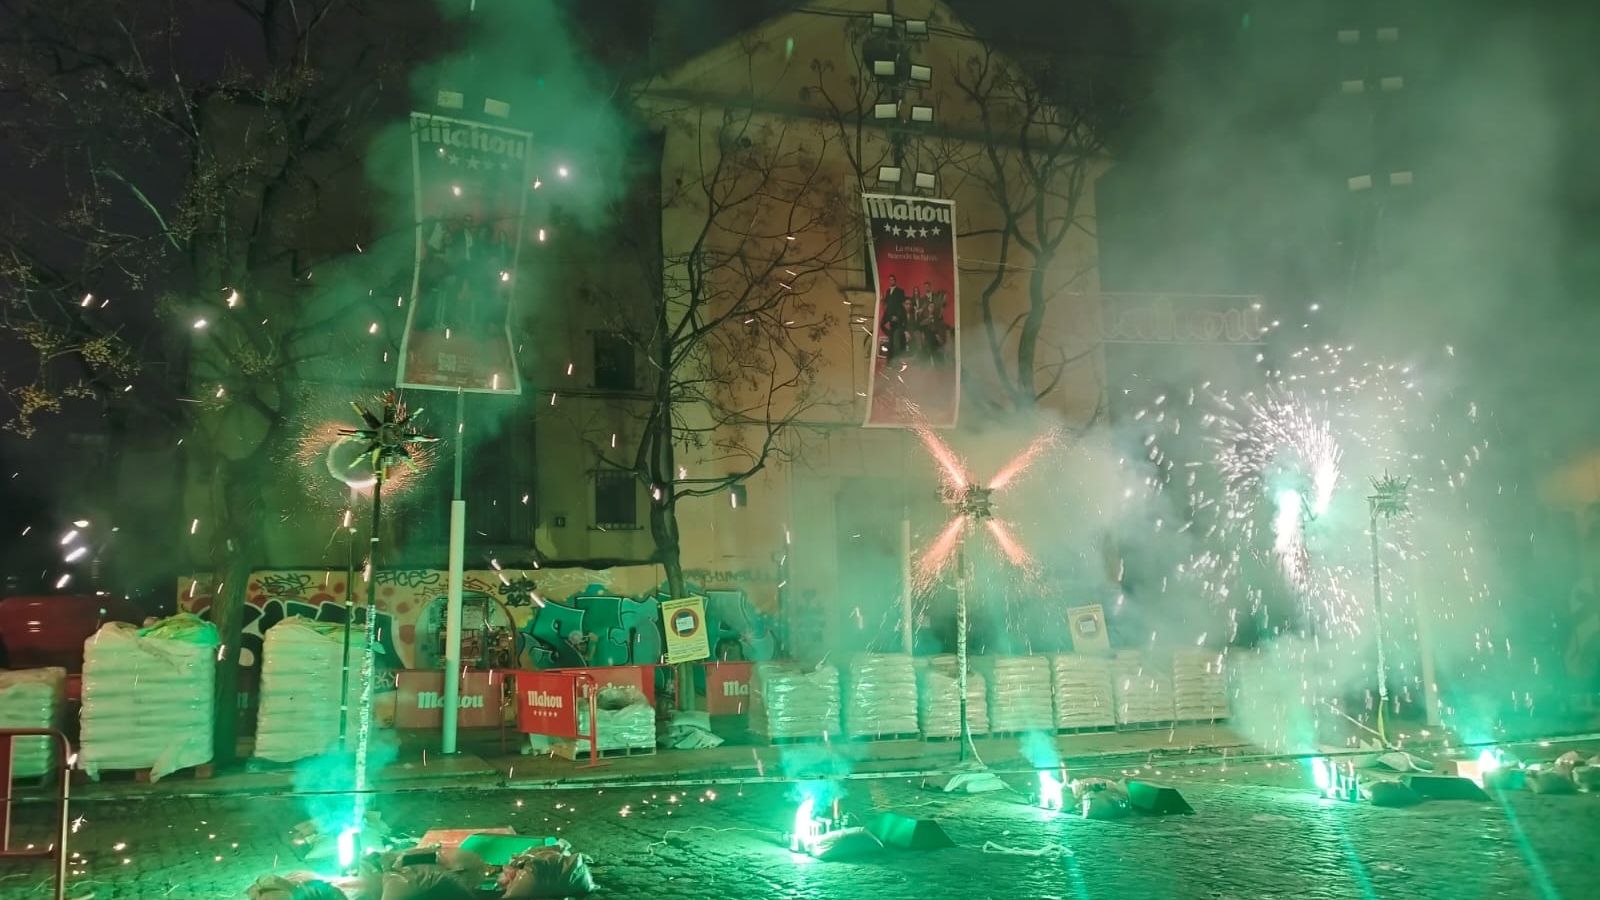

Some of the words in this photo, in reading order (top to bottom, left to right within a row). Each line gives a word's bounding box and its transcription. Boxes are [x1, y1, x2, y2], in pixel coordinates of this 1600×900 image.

[418, 120, 523, 158] Mahou
[868, 197, 951, 225] Mahou
[417, 691, 485, 709] Maou
[528, 690, 563, 709] Mahou
